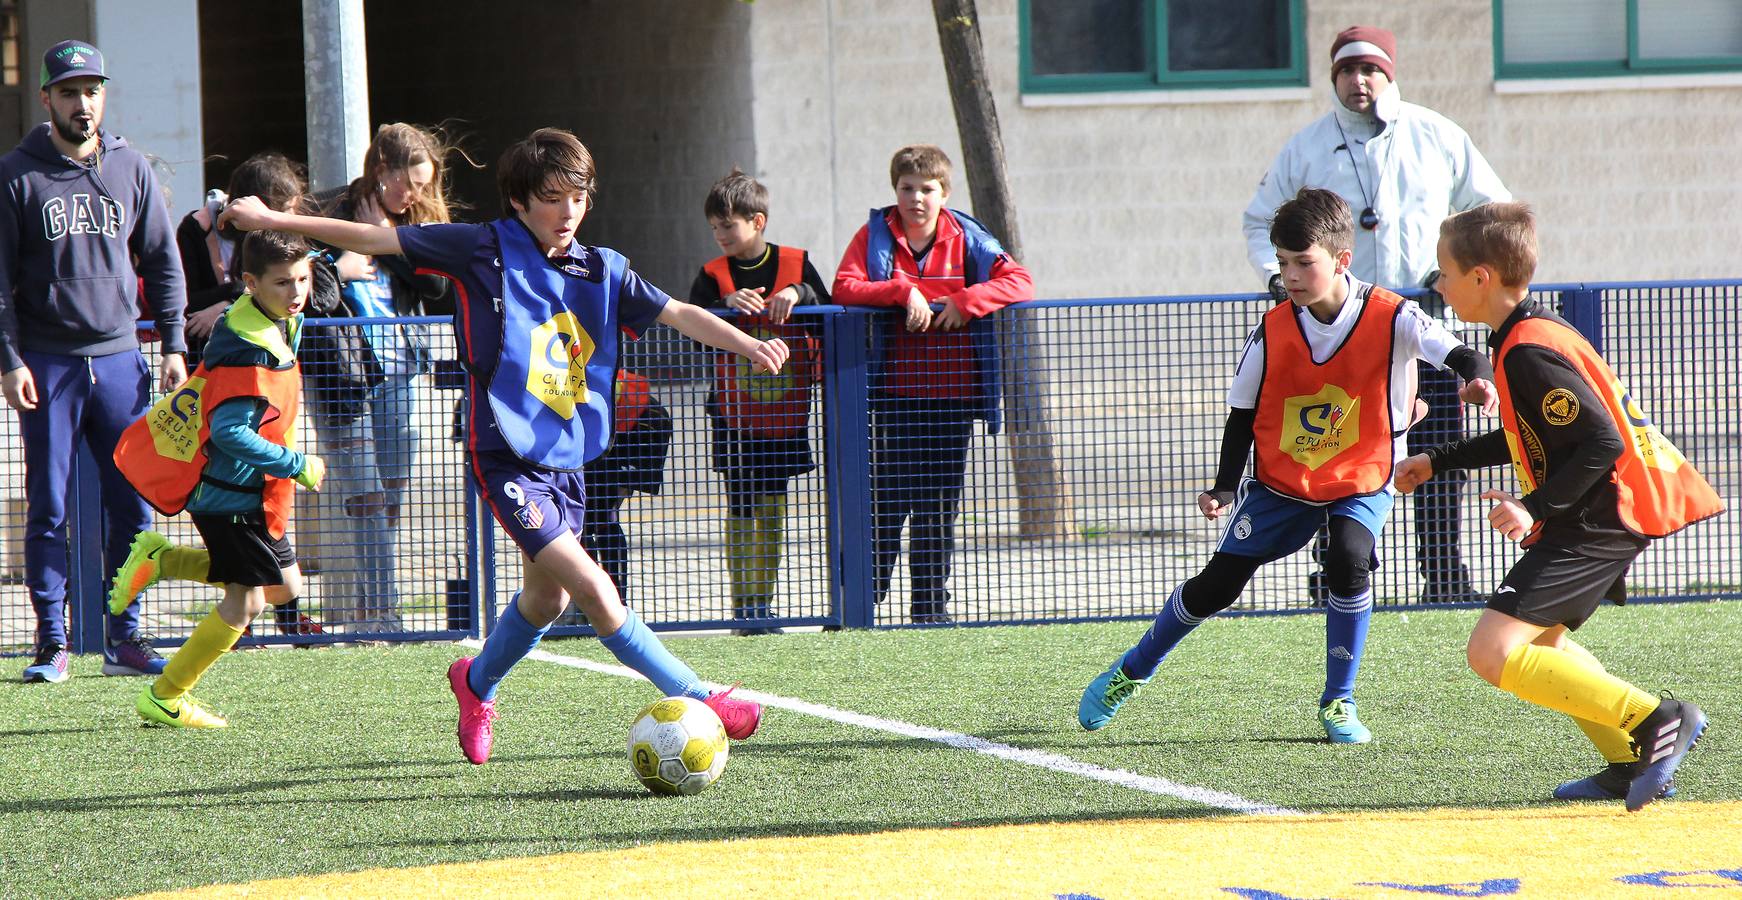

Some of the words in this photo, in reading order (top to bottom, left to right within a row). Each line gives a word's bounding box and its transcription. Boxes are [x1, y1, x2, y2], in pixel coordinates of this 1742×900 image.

[42, 193, 125, 241] GAP
[153, 420, 185, 455] FOUNDAON
[503, 481, 526, 507] 9
